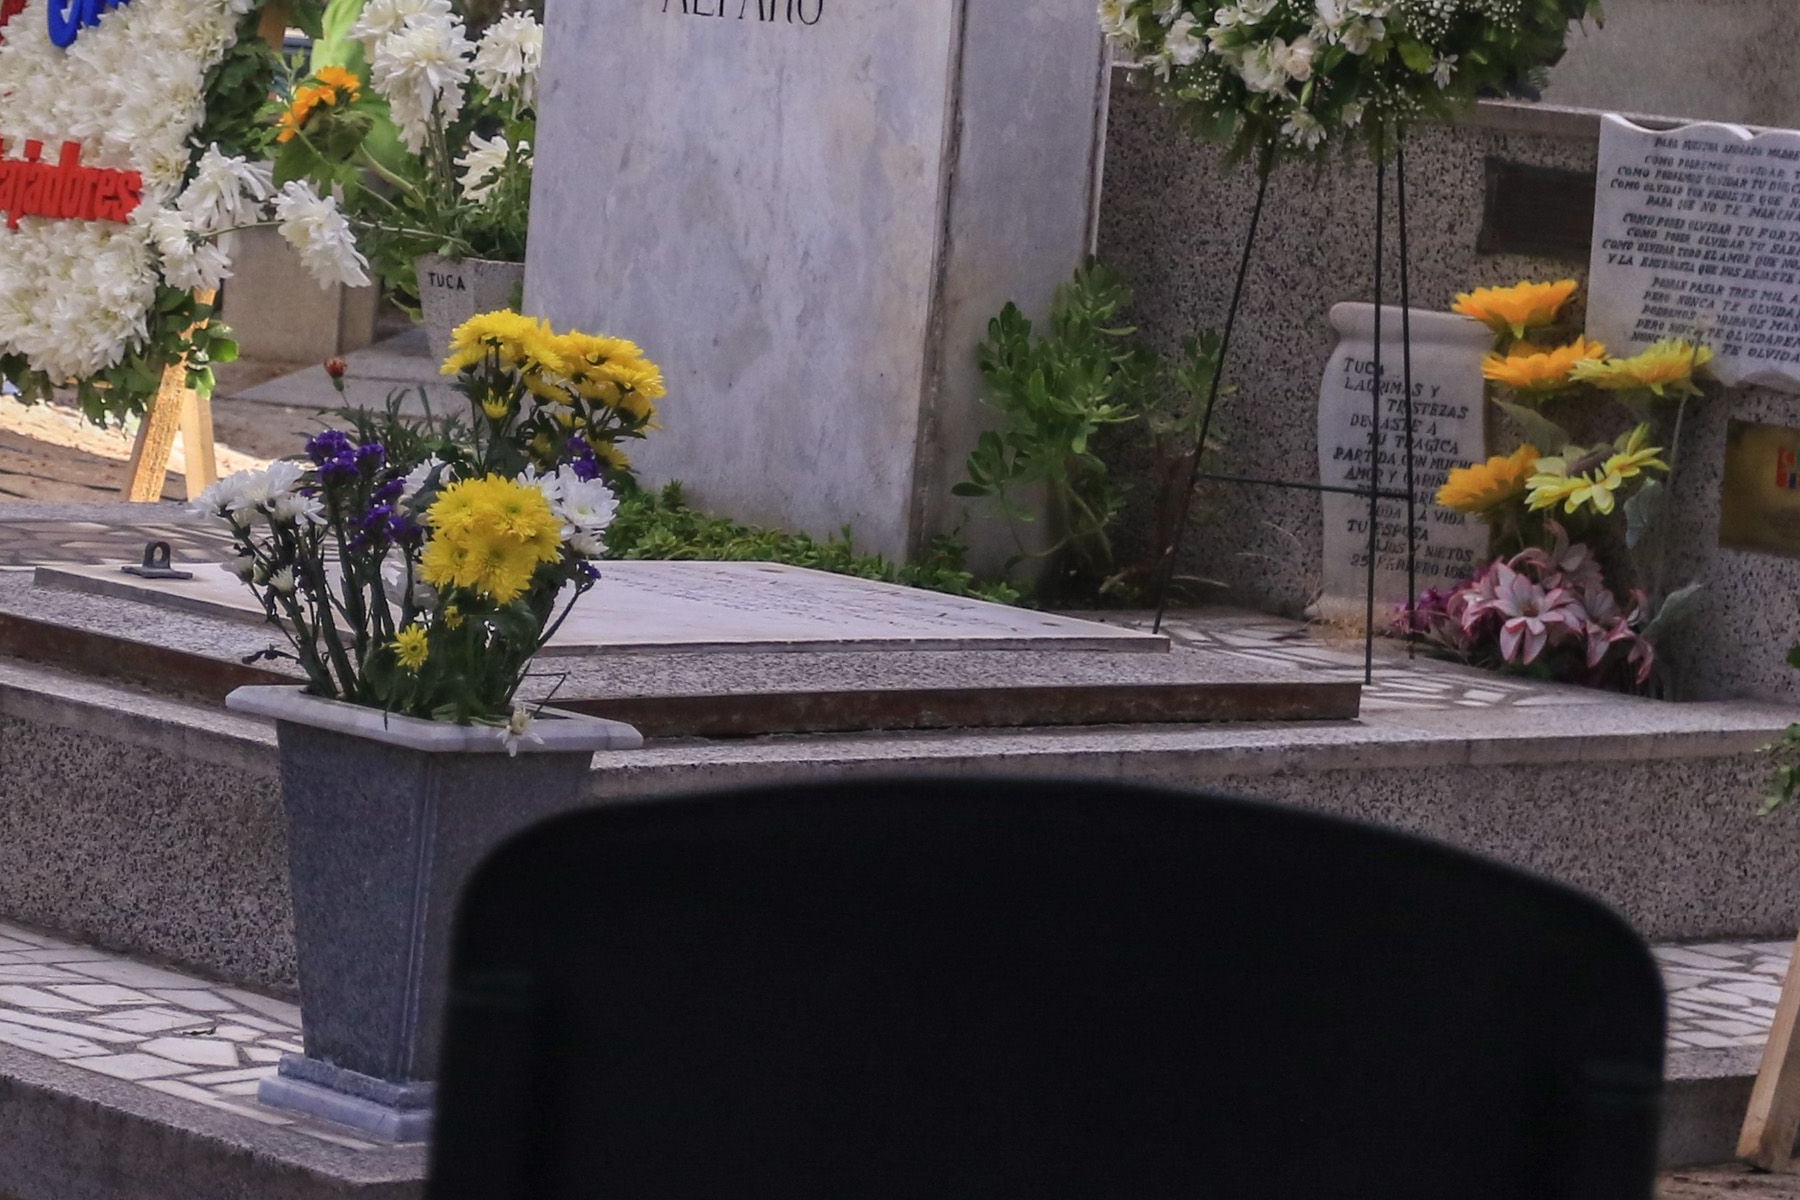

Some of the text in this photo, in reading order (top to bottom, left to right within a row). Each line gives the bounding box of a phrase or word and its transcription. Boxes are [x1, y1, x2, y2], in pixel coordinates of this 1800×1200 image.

[1645, 155, 1674, 168] COMO
[1617, 166, 1649, 178] COMO
[1610, 178, 1640, 191] COMO
[1622, 212, 1654, 226] COMO
[1737, 225, 1755, 239] TU
[1626, 227, 1657, 240] COMO
[1601, 238, 1634, 250] COMO
[428, 272, 466, 291] TUCA
[1728, 286, 1758, 300] TRES
[1760, 290, 1784, 303] MIL
[1721, 300, 1741, 313] TE
[1721, 343, 1743, 357] TE
[1431, 384, 1441, 398] Y
[1387, 398, 1470, 420] TRSTEZAS
[1426, 420, 1438, 437] A
[1332, 446, 1396, 466] PARTDA
[1388, 470, 1398, 484] Y
[1347, 519, 1369, 534] TU
[1349, 553, 1370, 568] 25
